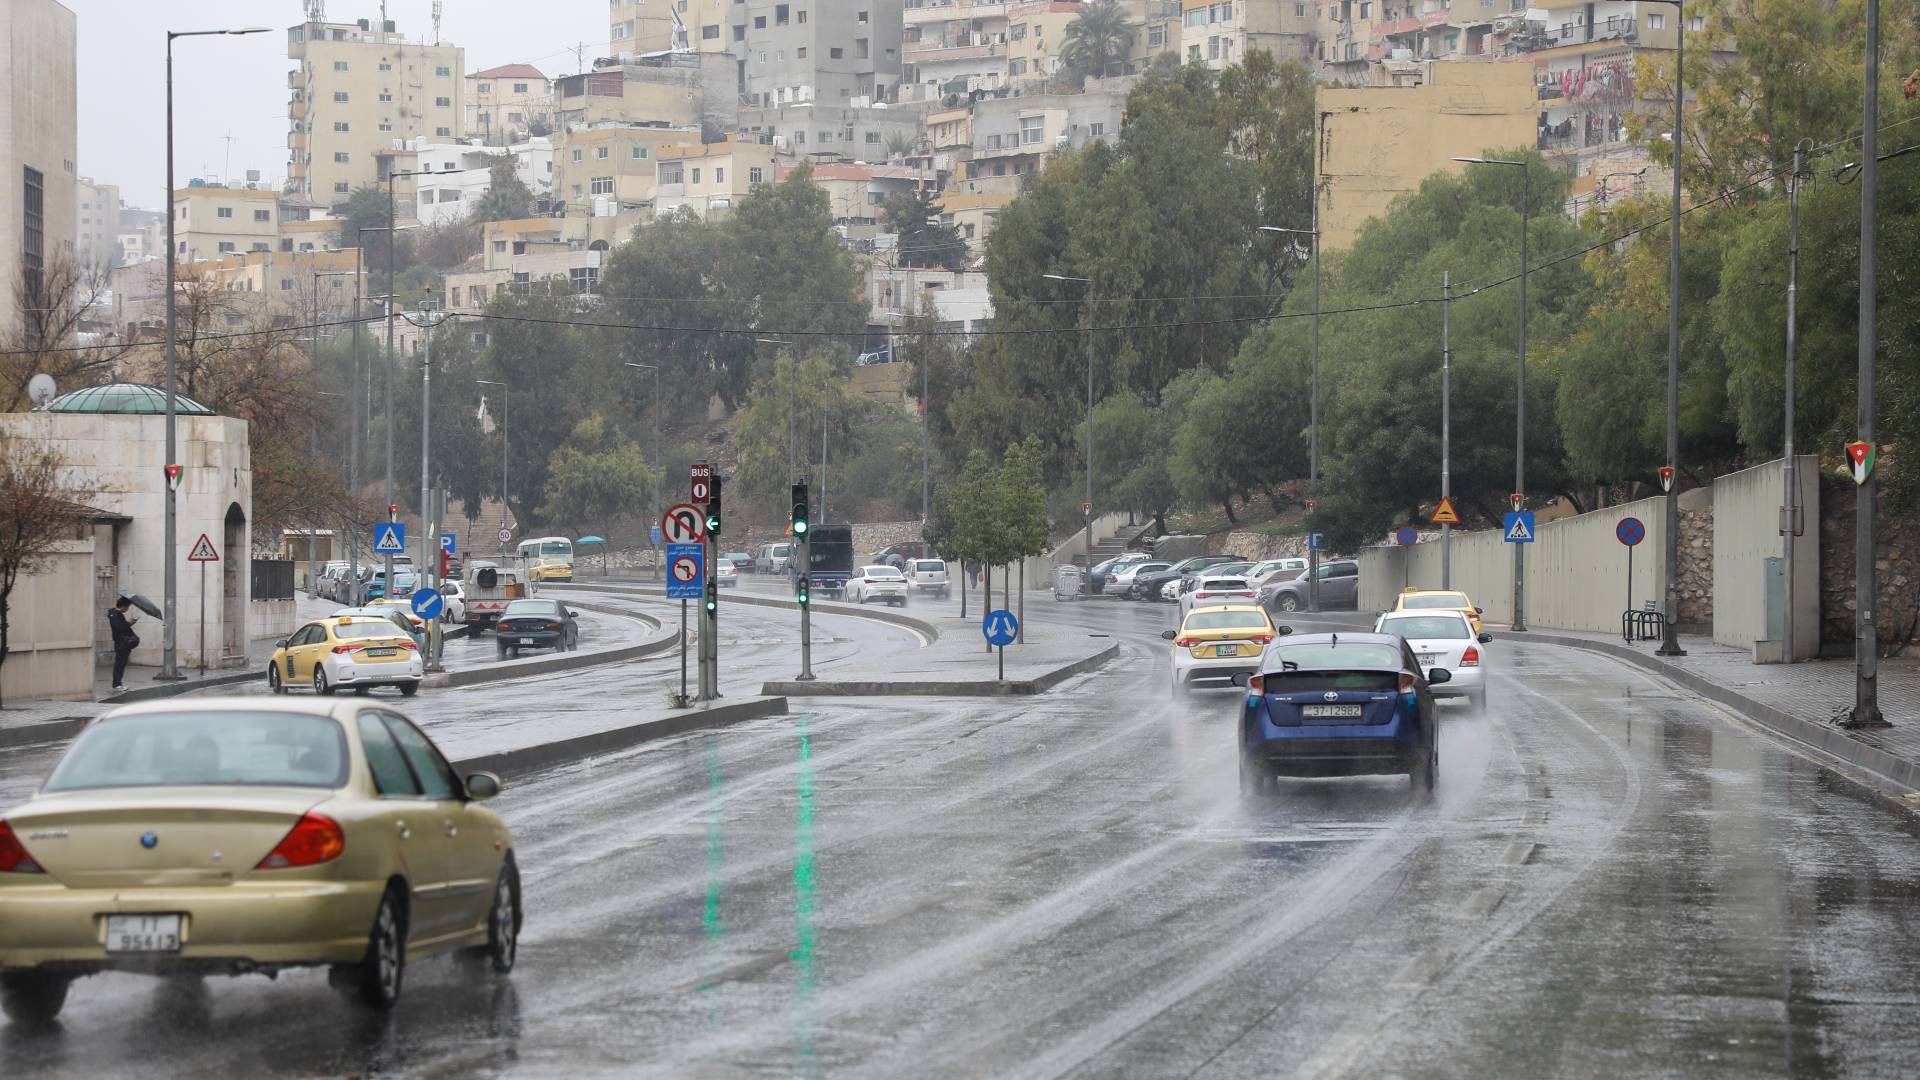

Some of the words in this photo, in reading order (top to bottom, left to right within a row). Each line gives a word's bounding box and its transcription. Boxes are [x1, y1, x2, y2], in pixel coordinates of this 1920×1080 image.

[691, 468, 709, 477] BUS
[500, 531, 510, 540] 50
[440, 536, 452, 550] P
